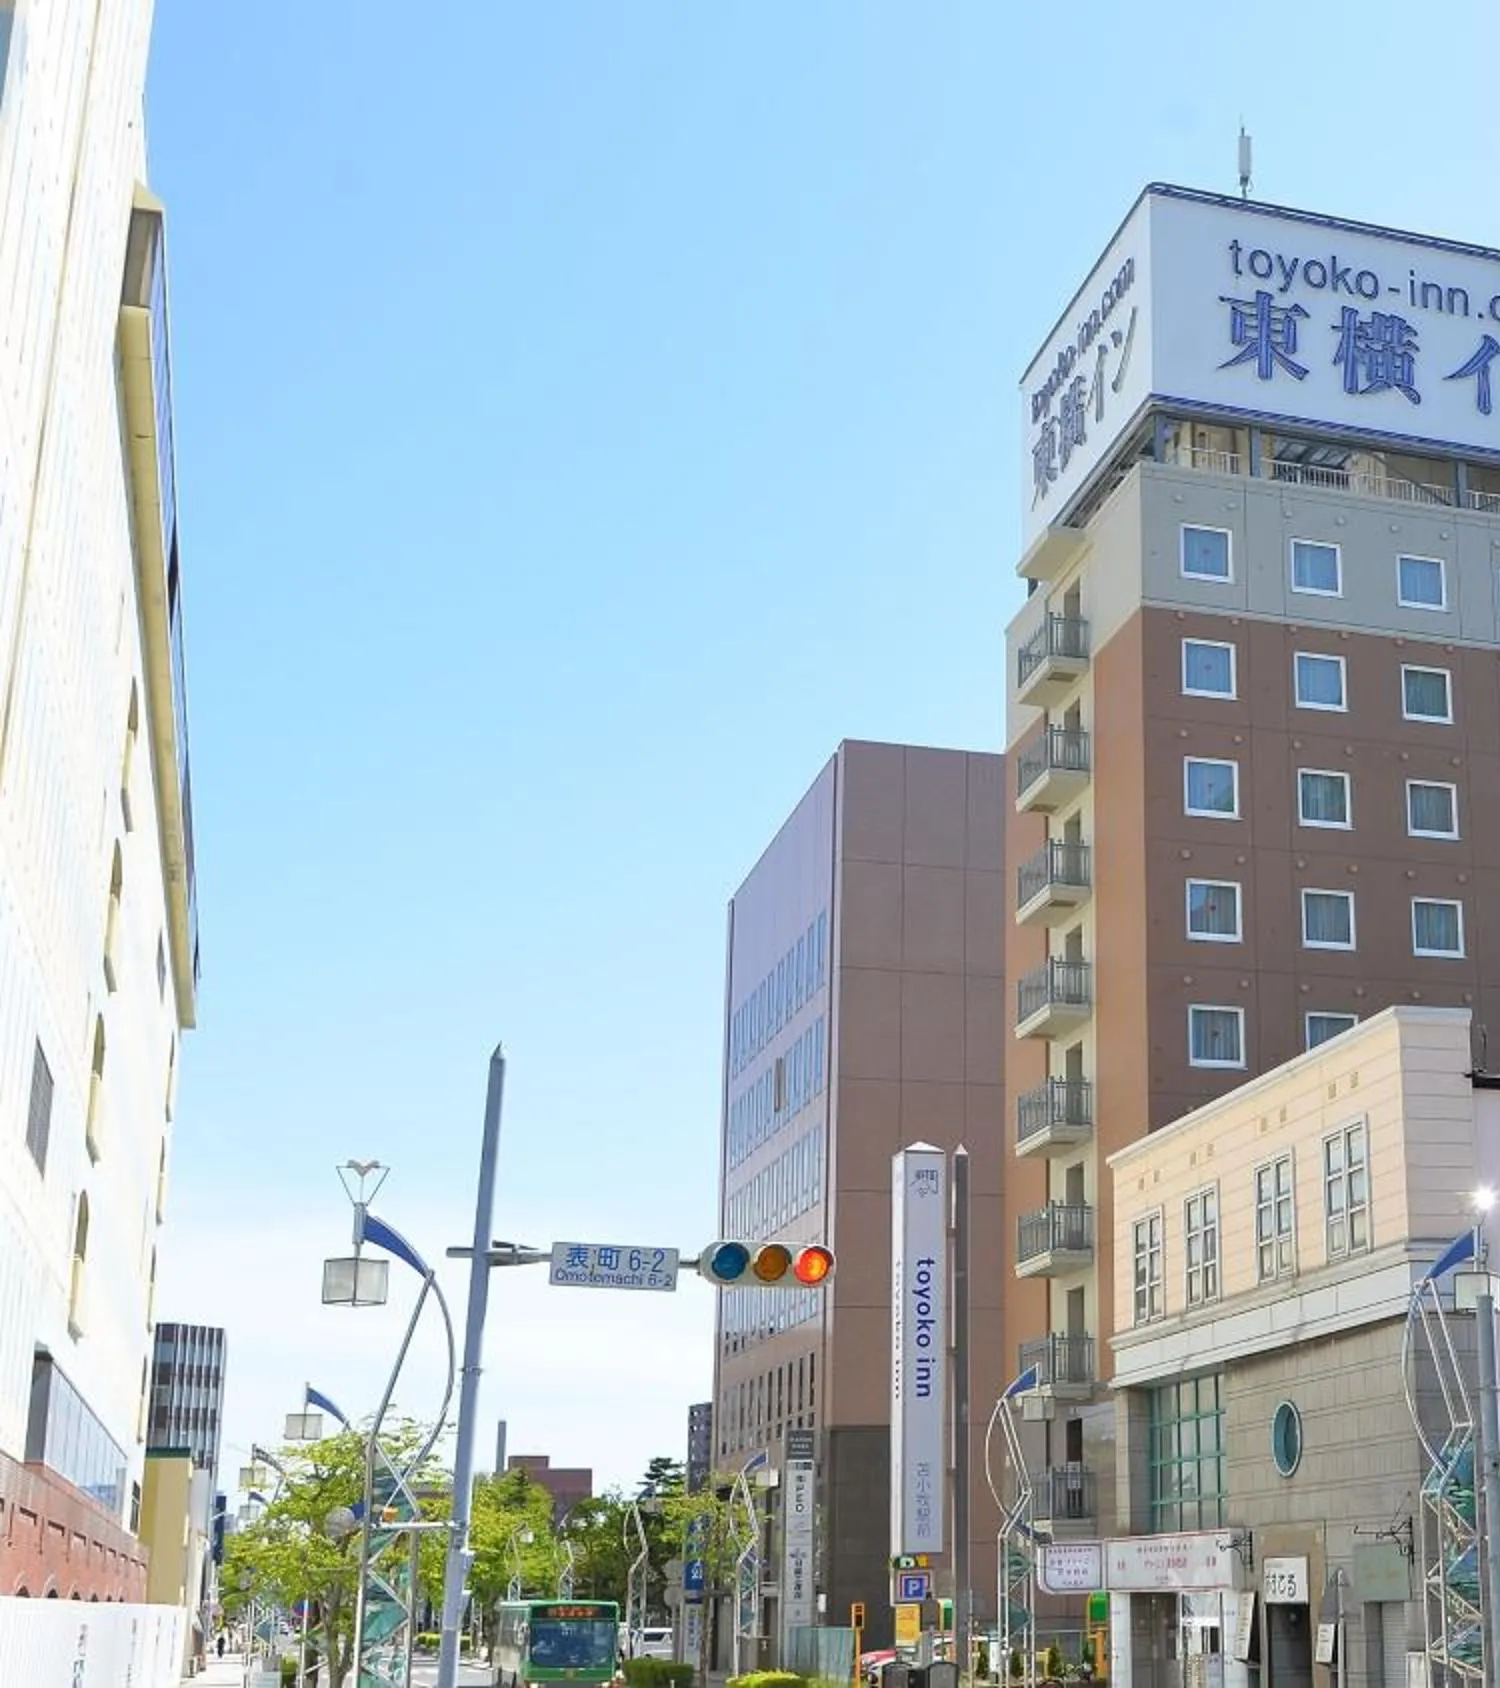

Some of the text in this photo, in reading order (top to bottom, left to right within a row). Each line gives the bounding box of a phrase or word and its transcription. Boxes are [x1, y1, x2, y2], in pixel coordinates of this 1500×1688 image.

[565, 1244, 666, 1273] 表町 6-2
[912, 1257, 937, 1398] toyoko inn
[908, 1579, 921, 1595] P
